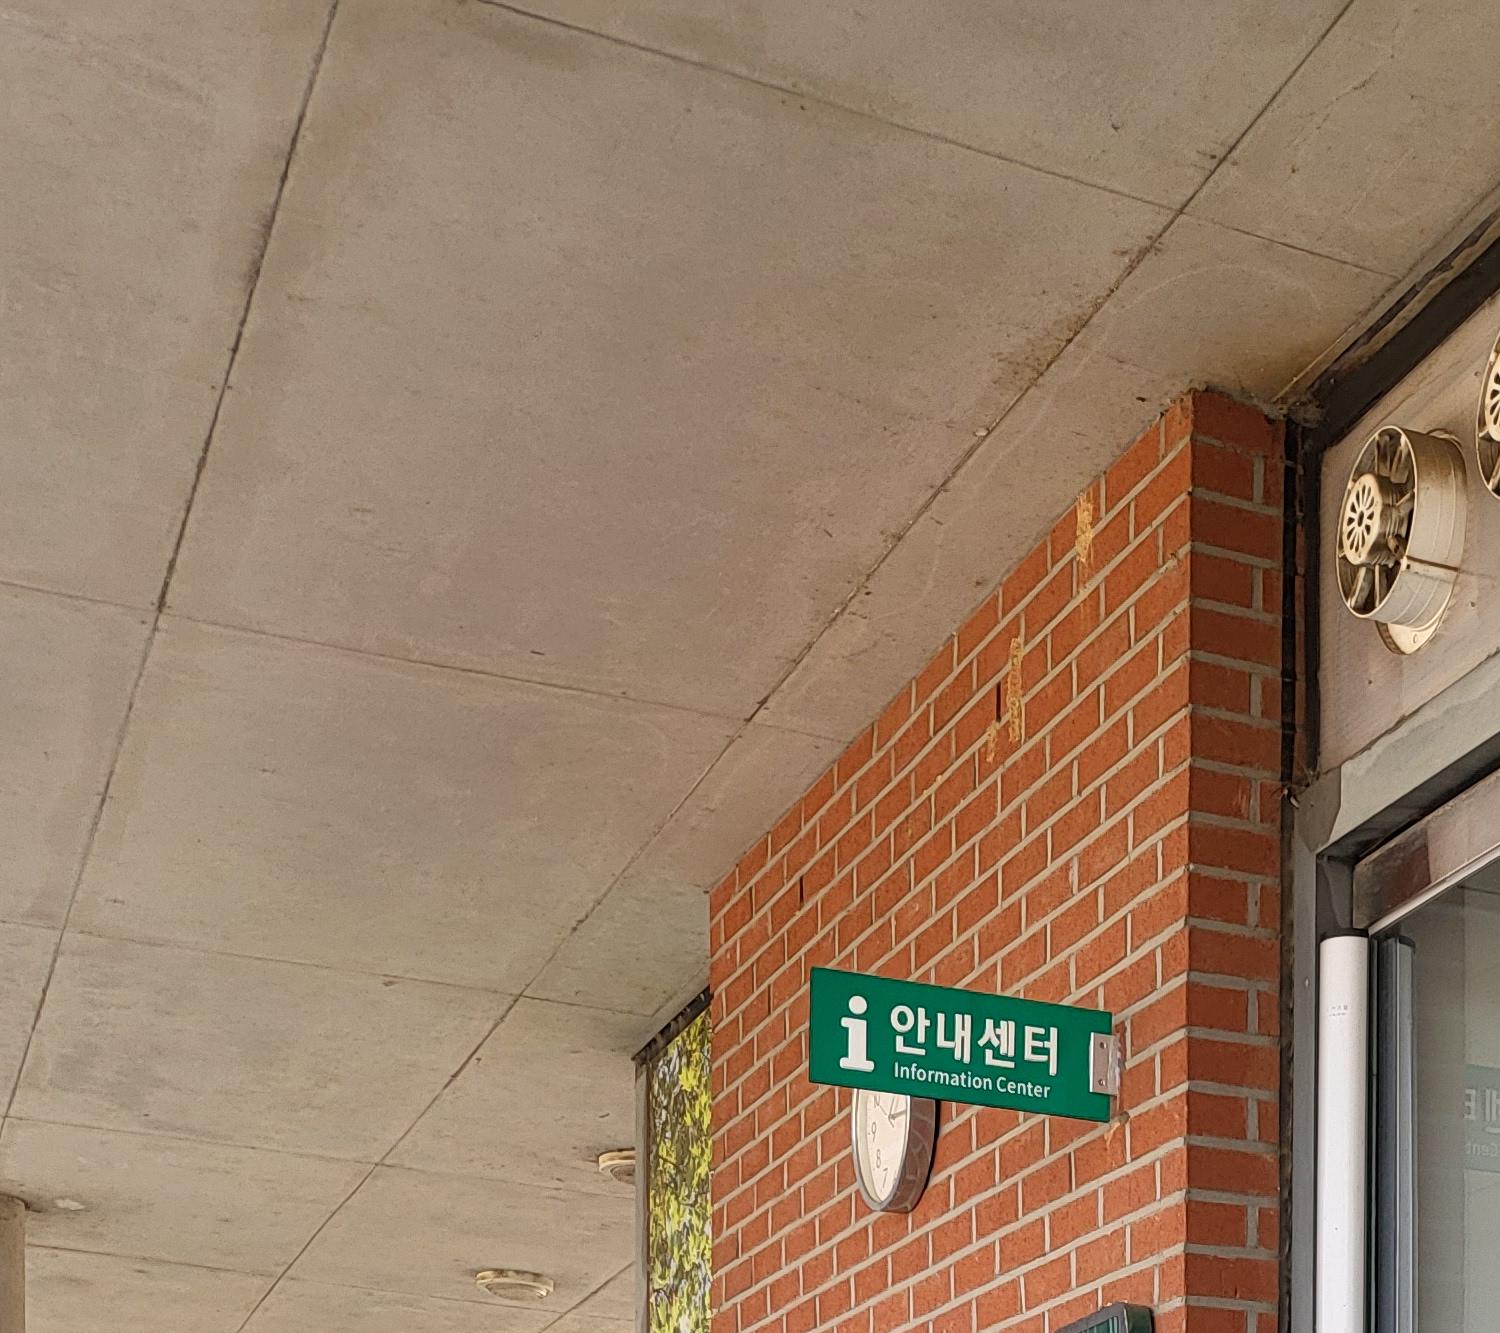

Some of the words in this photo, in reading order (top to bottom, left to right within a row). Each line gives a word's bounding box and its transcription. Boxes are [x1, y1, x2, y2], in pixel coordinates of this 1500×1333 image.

[890, 1004, 1059, 1077] 안내센터
[894, 1061, 993, 1092] Information
[996, 1076, 1051, 1099] Center
